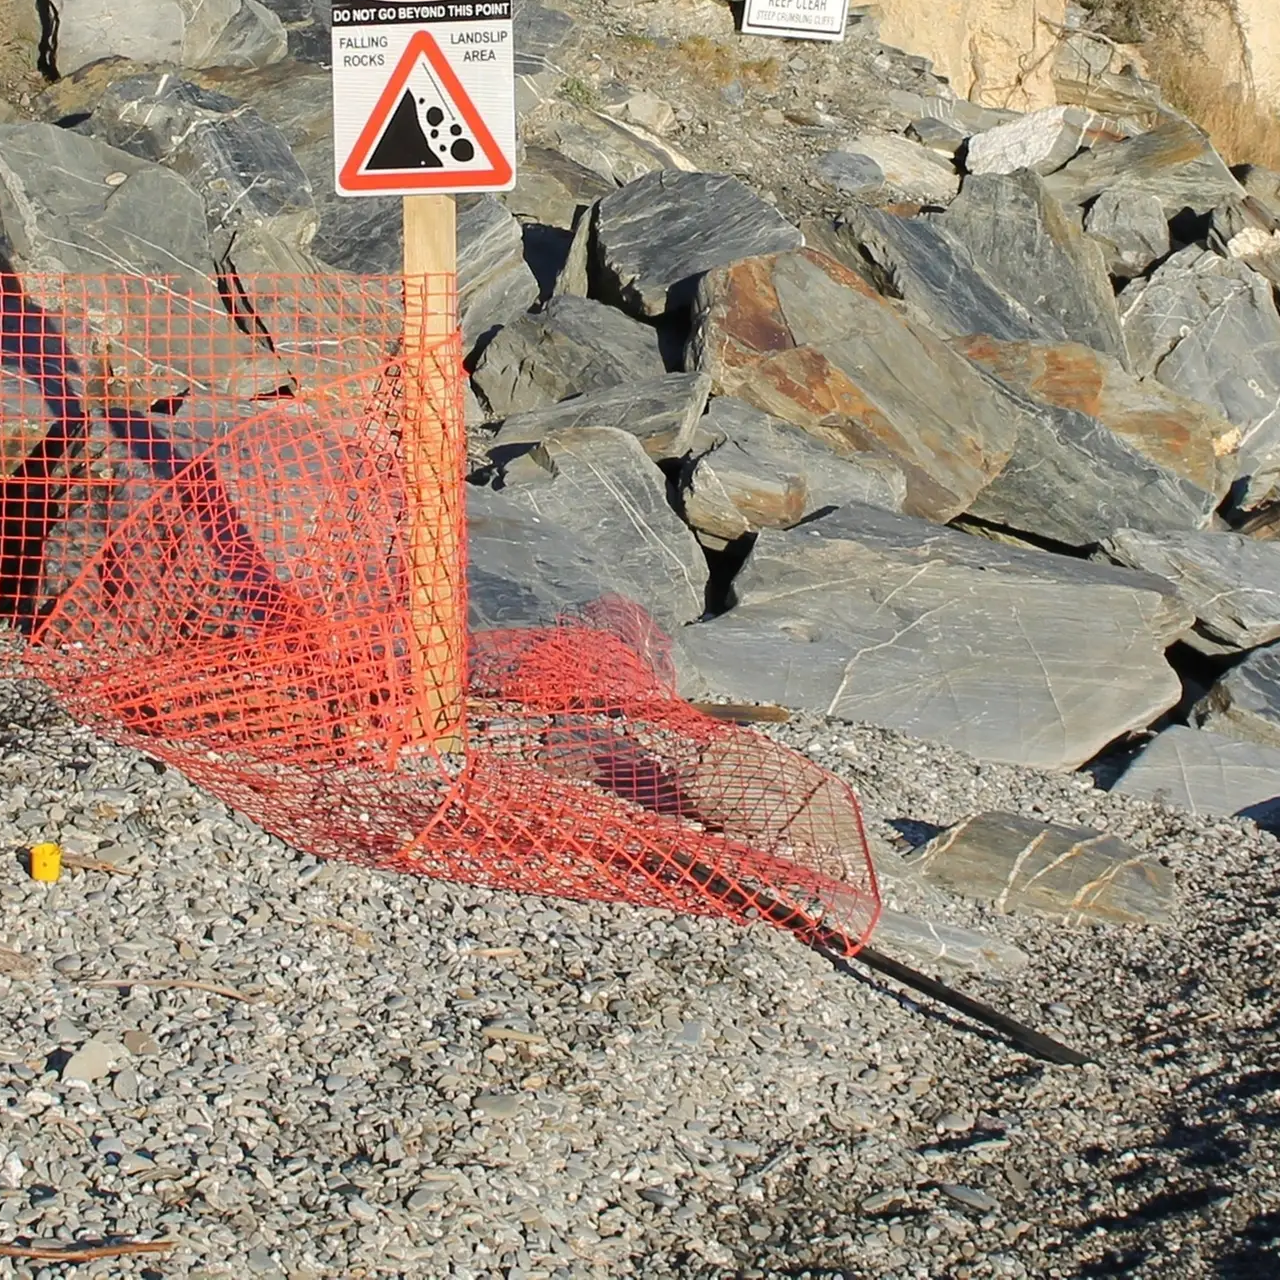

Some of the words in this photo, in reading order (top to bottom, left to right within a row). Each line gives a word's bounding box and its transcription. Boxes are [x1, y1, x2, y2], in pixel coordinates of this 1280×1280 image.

[333, 10, 351, 22] DO
[353, 9, 376, 21] NOT
[378, 8, 396, 20] GO
[398, 6, 445, 19] BEYOND
[448, 4, 473, 17] THIS
[475, 2, 509, 16] POINT
[339, 36, 388, 49] FALLING
[451, 31, 508, 45] LANDSLIP
[344, 54, 385, 67] ROCKS
[463, 50, 496, 62] AREA
